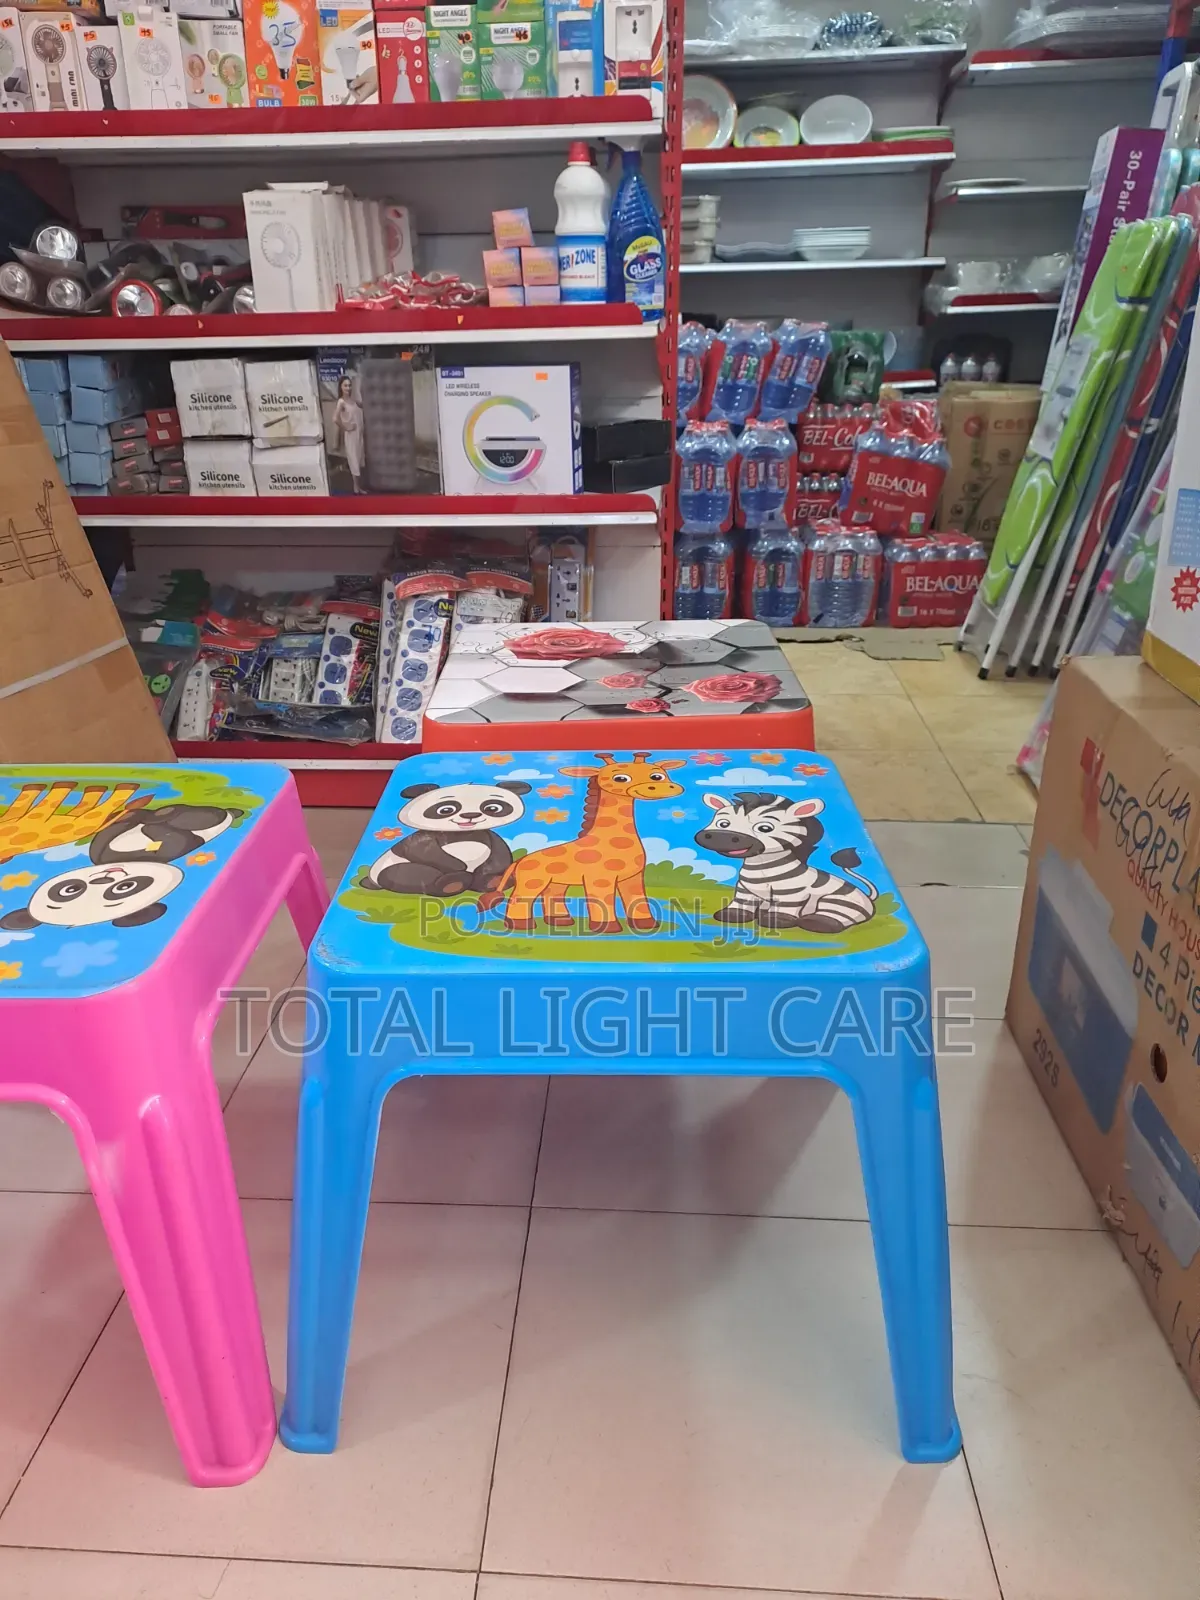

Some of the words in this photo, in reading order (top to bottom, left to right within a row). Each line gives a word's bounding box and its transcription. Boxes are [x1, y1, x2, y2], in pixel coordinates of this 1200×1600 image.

[450, 8, 468, 17] ANGEL
[320, 16, 338, 27] LED
[268, 20, 297, 48] 35
[493, 27, 509, 35] NIGHT
[258, 99, 280, 107] BULB
[1116, 150, 1143, 213] 30-Pair
[575, 248, 596, 266] ZONE
[629, 257, 662, 276] GLASS
[190, 393, 232, 404] Silicone
[260, 394, 304, 405] Silicone
[213, 403, 237, 411] utensils
[200, 471, 240, 482] Silicone
[270, 474, 311, 484] Silicone
[221, 481, 246, 489] utensils
[354, 624, 378, 637] New
[1099, 771, 1200, 918] DECORPLA
[1159, 941, 1172, 972] 4
[1132, 950, 1190, 1047] DECOR
